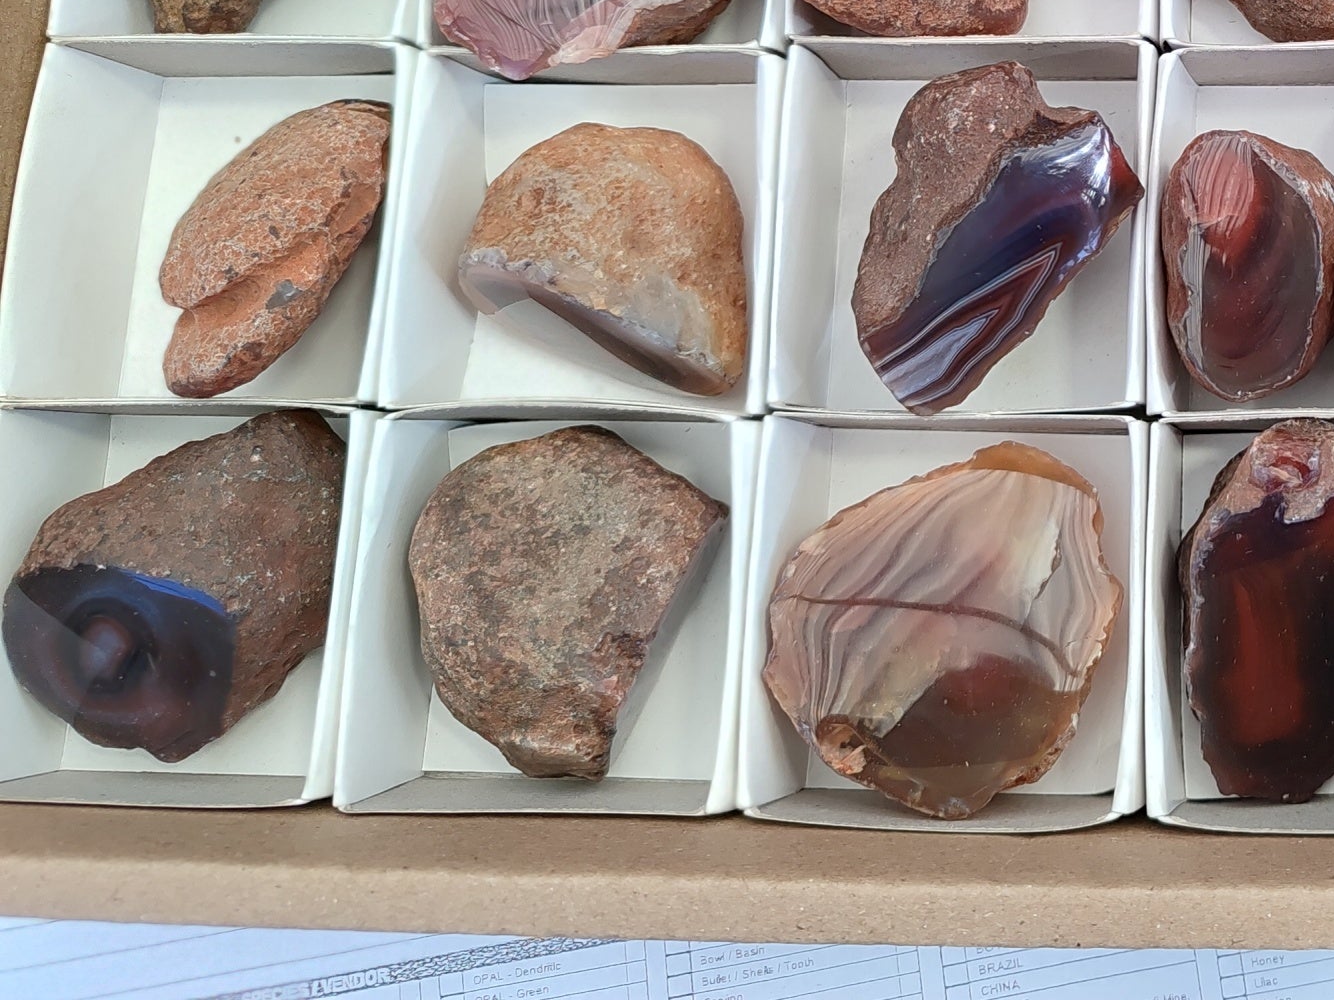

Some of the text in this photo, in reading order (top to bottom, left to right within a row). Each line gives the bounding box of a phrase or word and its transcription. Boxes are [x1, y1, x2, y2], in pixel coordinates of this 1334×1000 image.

[735, 946, 765, 959] Basin
[784, 957, 814, 971] Tooth
[978, 957, 1023, 975] BRAZIL
[1251, 954, 1285, 967] Honey
[473, 972, 504, 985] OPAL
[1254, 977, 1278, 988] Lilac
[516, 986, 549, 998] Green
[981, 980, 1021, 996] CHINA
